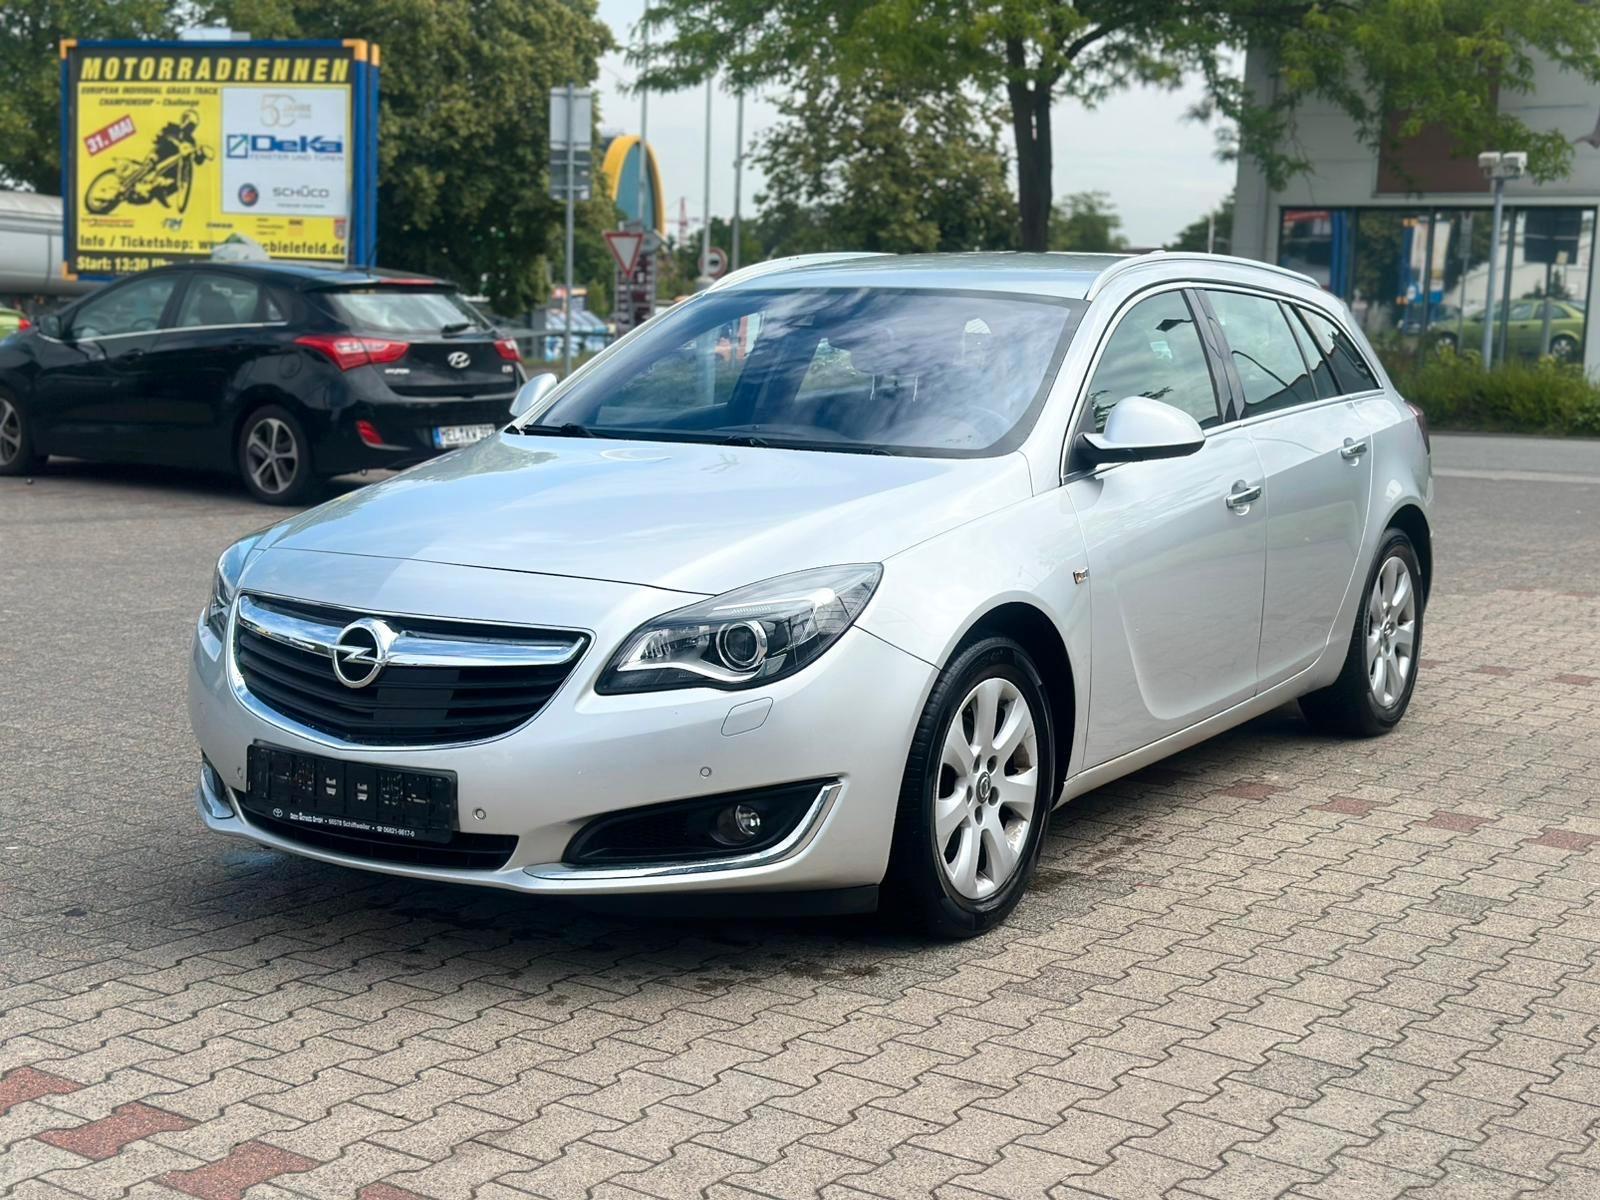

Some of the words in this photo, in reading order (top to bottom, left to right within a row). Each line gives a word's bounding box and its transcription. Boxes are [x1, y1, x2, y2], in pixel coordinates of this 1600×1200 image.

[81, 57, 349, 81] MOTORRADRENNEN
[194, 87, 219, 95] TRACK
[99, 98, 154, 107] CHAMPIONSHIP
[162, 99, 200, 108] Challenge
[86, 133, 111, 154] 31.
[107, 117, 135, 142] MAI
[251, 135, 343, 153] DeKa
[273, 185, 330, 199] SCHÜCO
[80, 235, 106, 248] Info
[119, 236, 194, 251] Ticketshop:
[76, 256, 112, 271] Start:
[115, 257, 150, 272] 13:30
